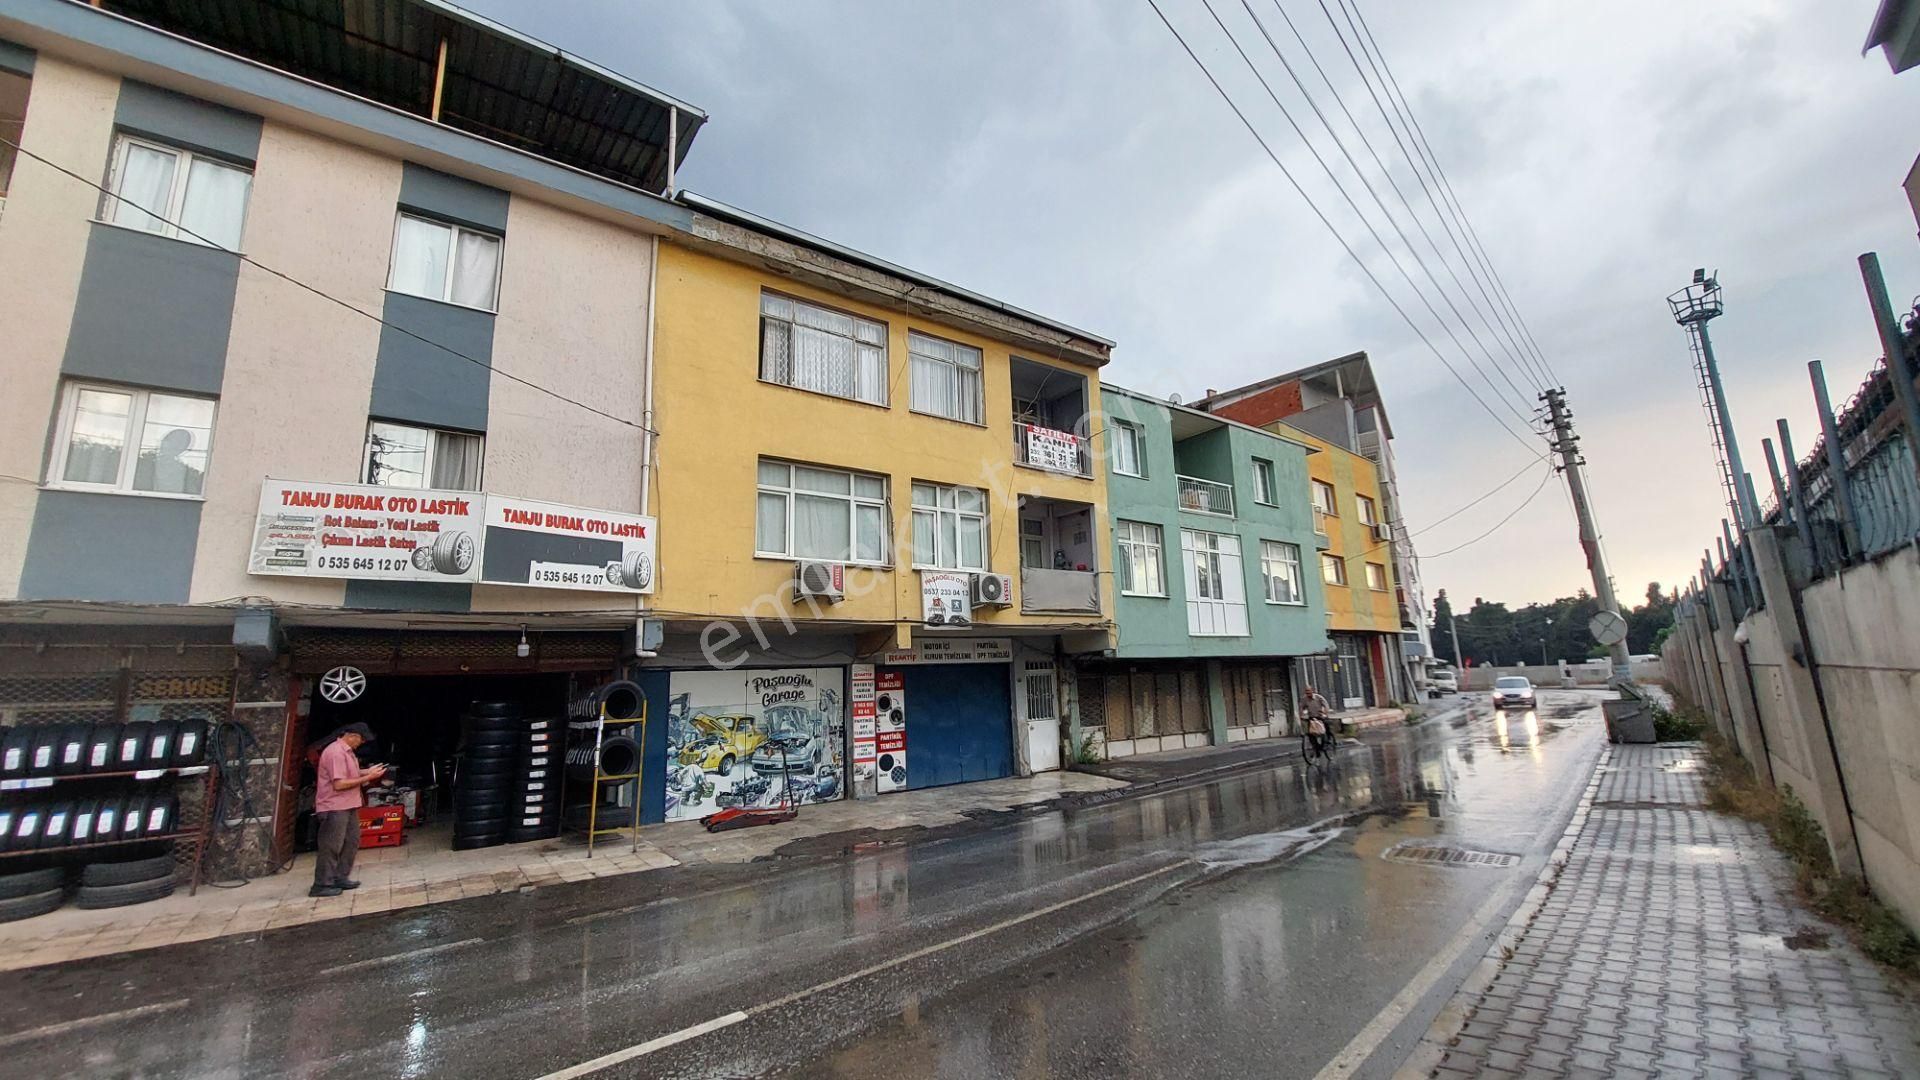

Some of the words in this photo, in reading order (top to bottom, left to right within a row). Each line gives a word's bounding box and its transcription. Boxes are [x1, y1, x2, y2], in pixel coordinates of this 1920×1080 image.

[1032, 434, 1074, 450] KANIT
[281, 490, 331, 508] TANJU
[334, 493, 385, 511] BURAK
[387, 497, 417, 513] OTO
[420, 497, 470, 516] LASTİK
[324, 514, 342, 527] Rot
[344, 515, 378, 529] Balans
[386, 517, 408, 531] Yeni
[410, 518, 440, 532] Lastik
[503, 508, 543, 526] TANJU
[545, 514, 585, 531] BURAK
[586, 519, 608, 534] OTO
[611, 522, 646, 539] LASTİK
[355, 535, 386, 548] Lastik
[318, 556, 326, 568] 0
[328, 557, 350, 569] 535
[353, 558, 374, 570] 645
[378, 559, 391, 571] 12
[394, 560, 408, 571] 07
[535, 570, 542, 580] 0
[543, 570, 560, 582] 535
[562, 572, 578, 583] 645
[582, 574, 591, 584] 12
[593, 574, 604, 585] 07
[956, 577, 967, 587] OTO
[752, 673, 814, 694] Paşaoğlu
[762, 690, 806, 707] Garage
